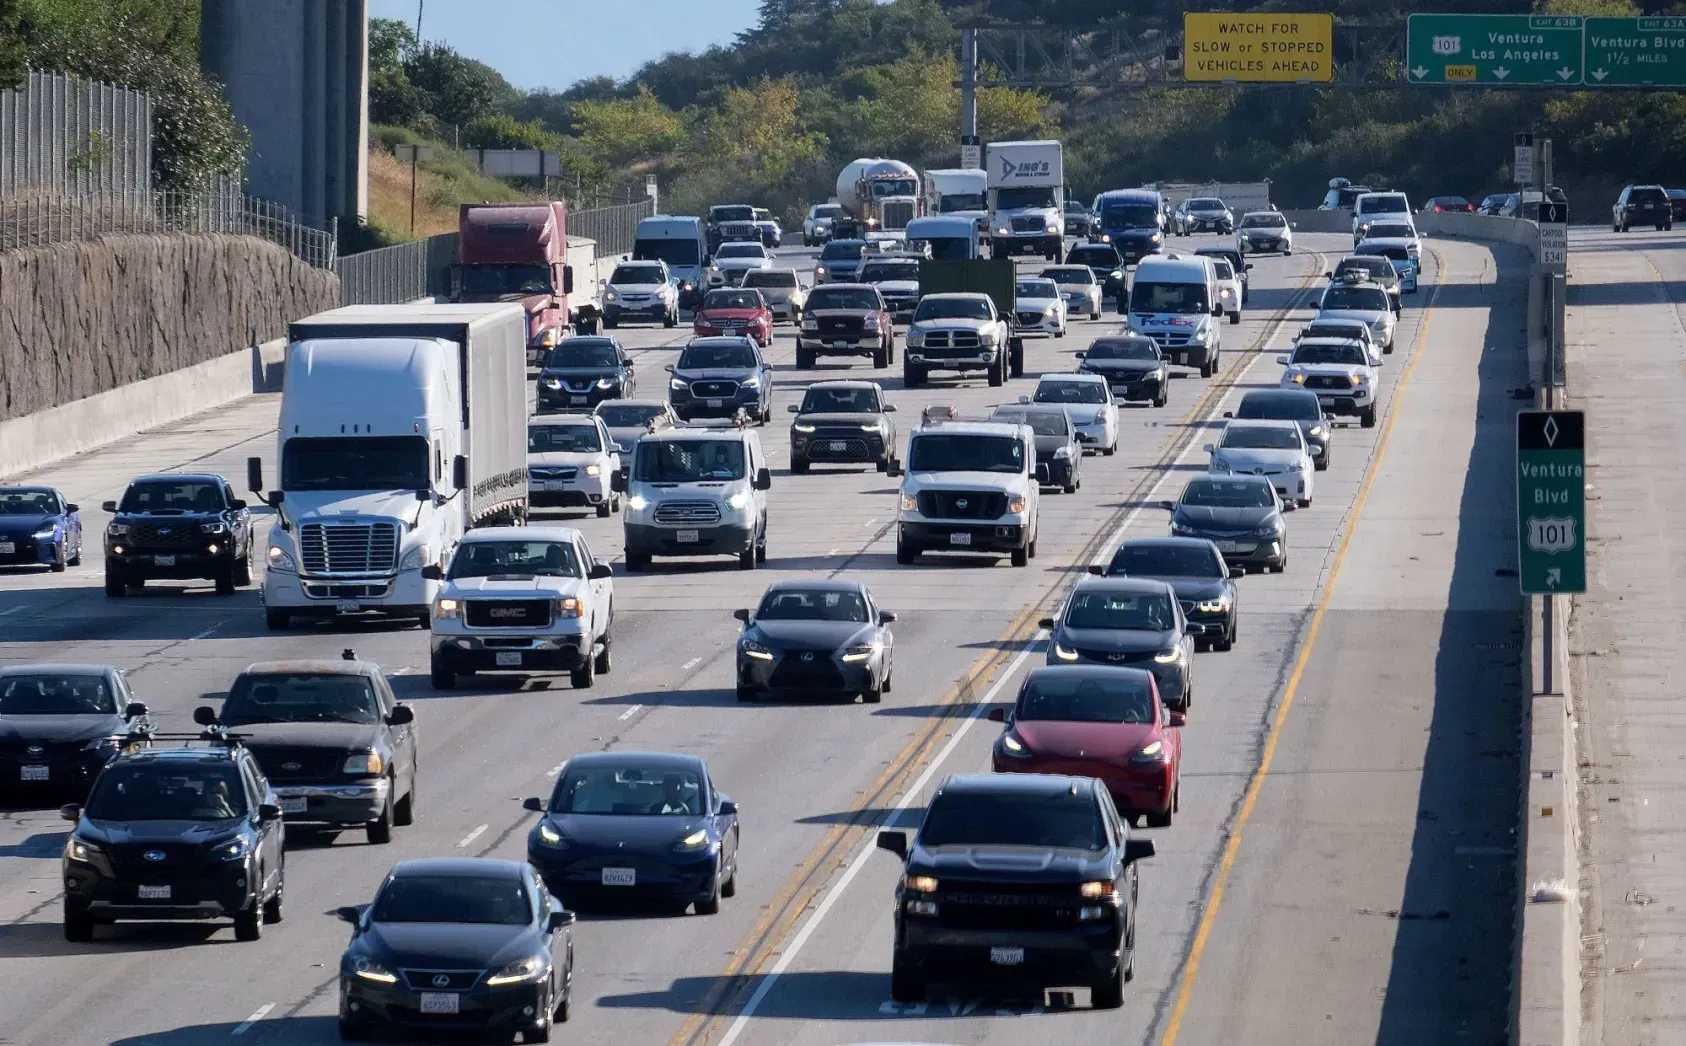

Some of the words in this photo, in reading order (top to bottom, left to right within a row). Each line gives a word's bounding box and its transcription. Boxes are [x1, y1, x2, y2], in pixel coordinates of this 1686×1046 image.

[1555, 18, 1577, 27] 63B
[1663, 20, 1685, 28] 63A
[1218, 23, 1264, 34] WATCH
[1271, 23, 1299, 34] FOR
[1488, 32, 1544, 44] Ventura
[1591, 36, 1647, 48] Ventura
[1654, 36, 1685, 48] Blvd
[1193, 42, 1230, 53] SLOW
[1238, 44, 1253, 53] or
[1261, 42, 1324, 53] STOPPED
[1438, 40, 1456, 50] 101
[1471, 49, 1495, 60] Los
[1503, 49, 1559, 63] Angeles
[1637, 54, 1668, 63] MILES
[1197, 60, 1264, 71] VEHICLES
[1272, 60, 1319, 71] AHEAD
[1447, 68, 1473, 78] ONLY
[1542, 229, 1564, 238] CARPOOL
[1541, 240, 1566, 249] VIOLATION
[1544, 251, 1563, 262] $341
[1135, 313, 1194, 328] FedEx
[1520, 462, 1582, 477] Ventura
[1534, 488, 1568, 503] Blvd
[1538, 525, 1566, 544] 101
[489, 608, 527, 618] GMC
